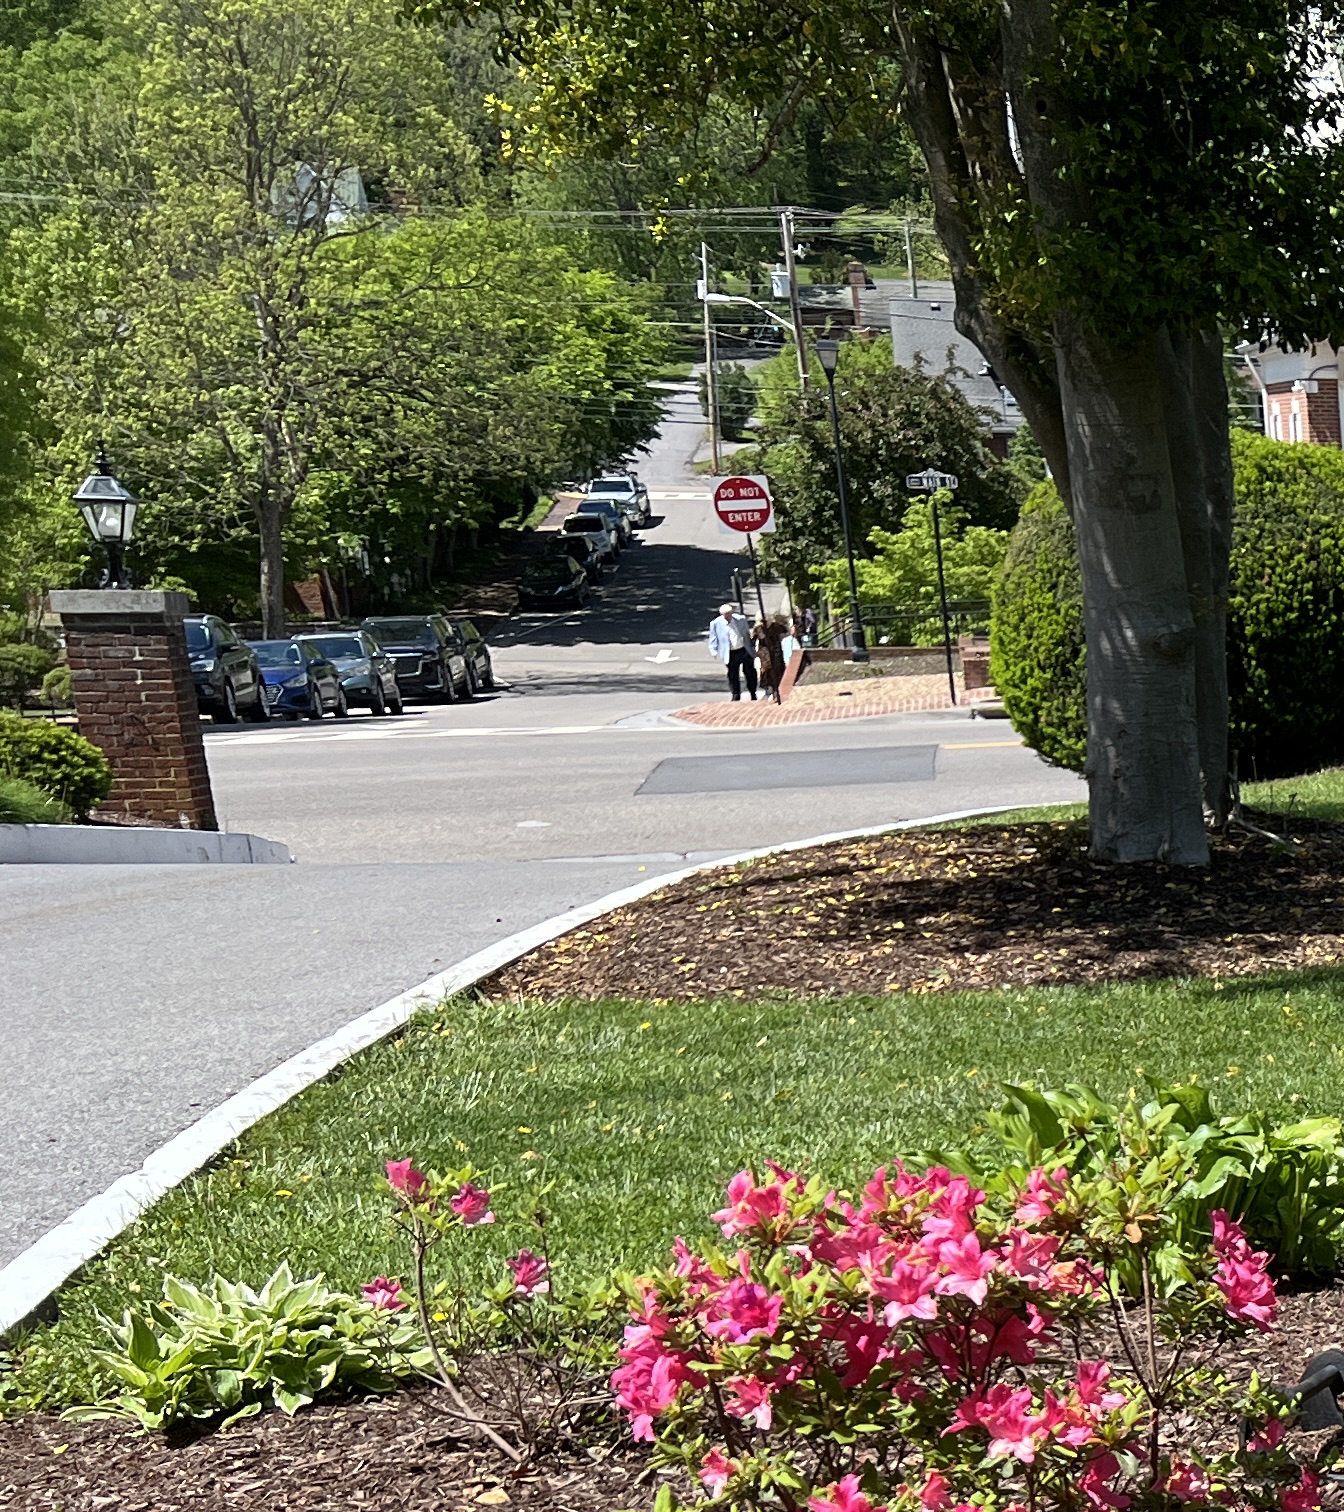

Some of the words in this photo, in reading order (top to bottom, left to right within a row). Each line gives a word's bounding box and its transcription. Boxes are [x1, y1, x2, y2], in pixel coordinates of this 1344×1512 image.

[719, 487, 735, 499] DO
[739, 486, 760, 497] NOT
[727, 511, 762, 523] ENTER
